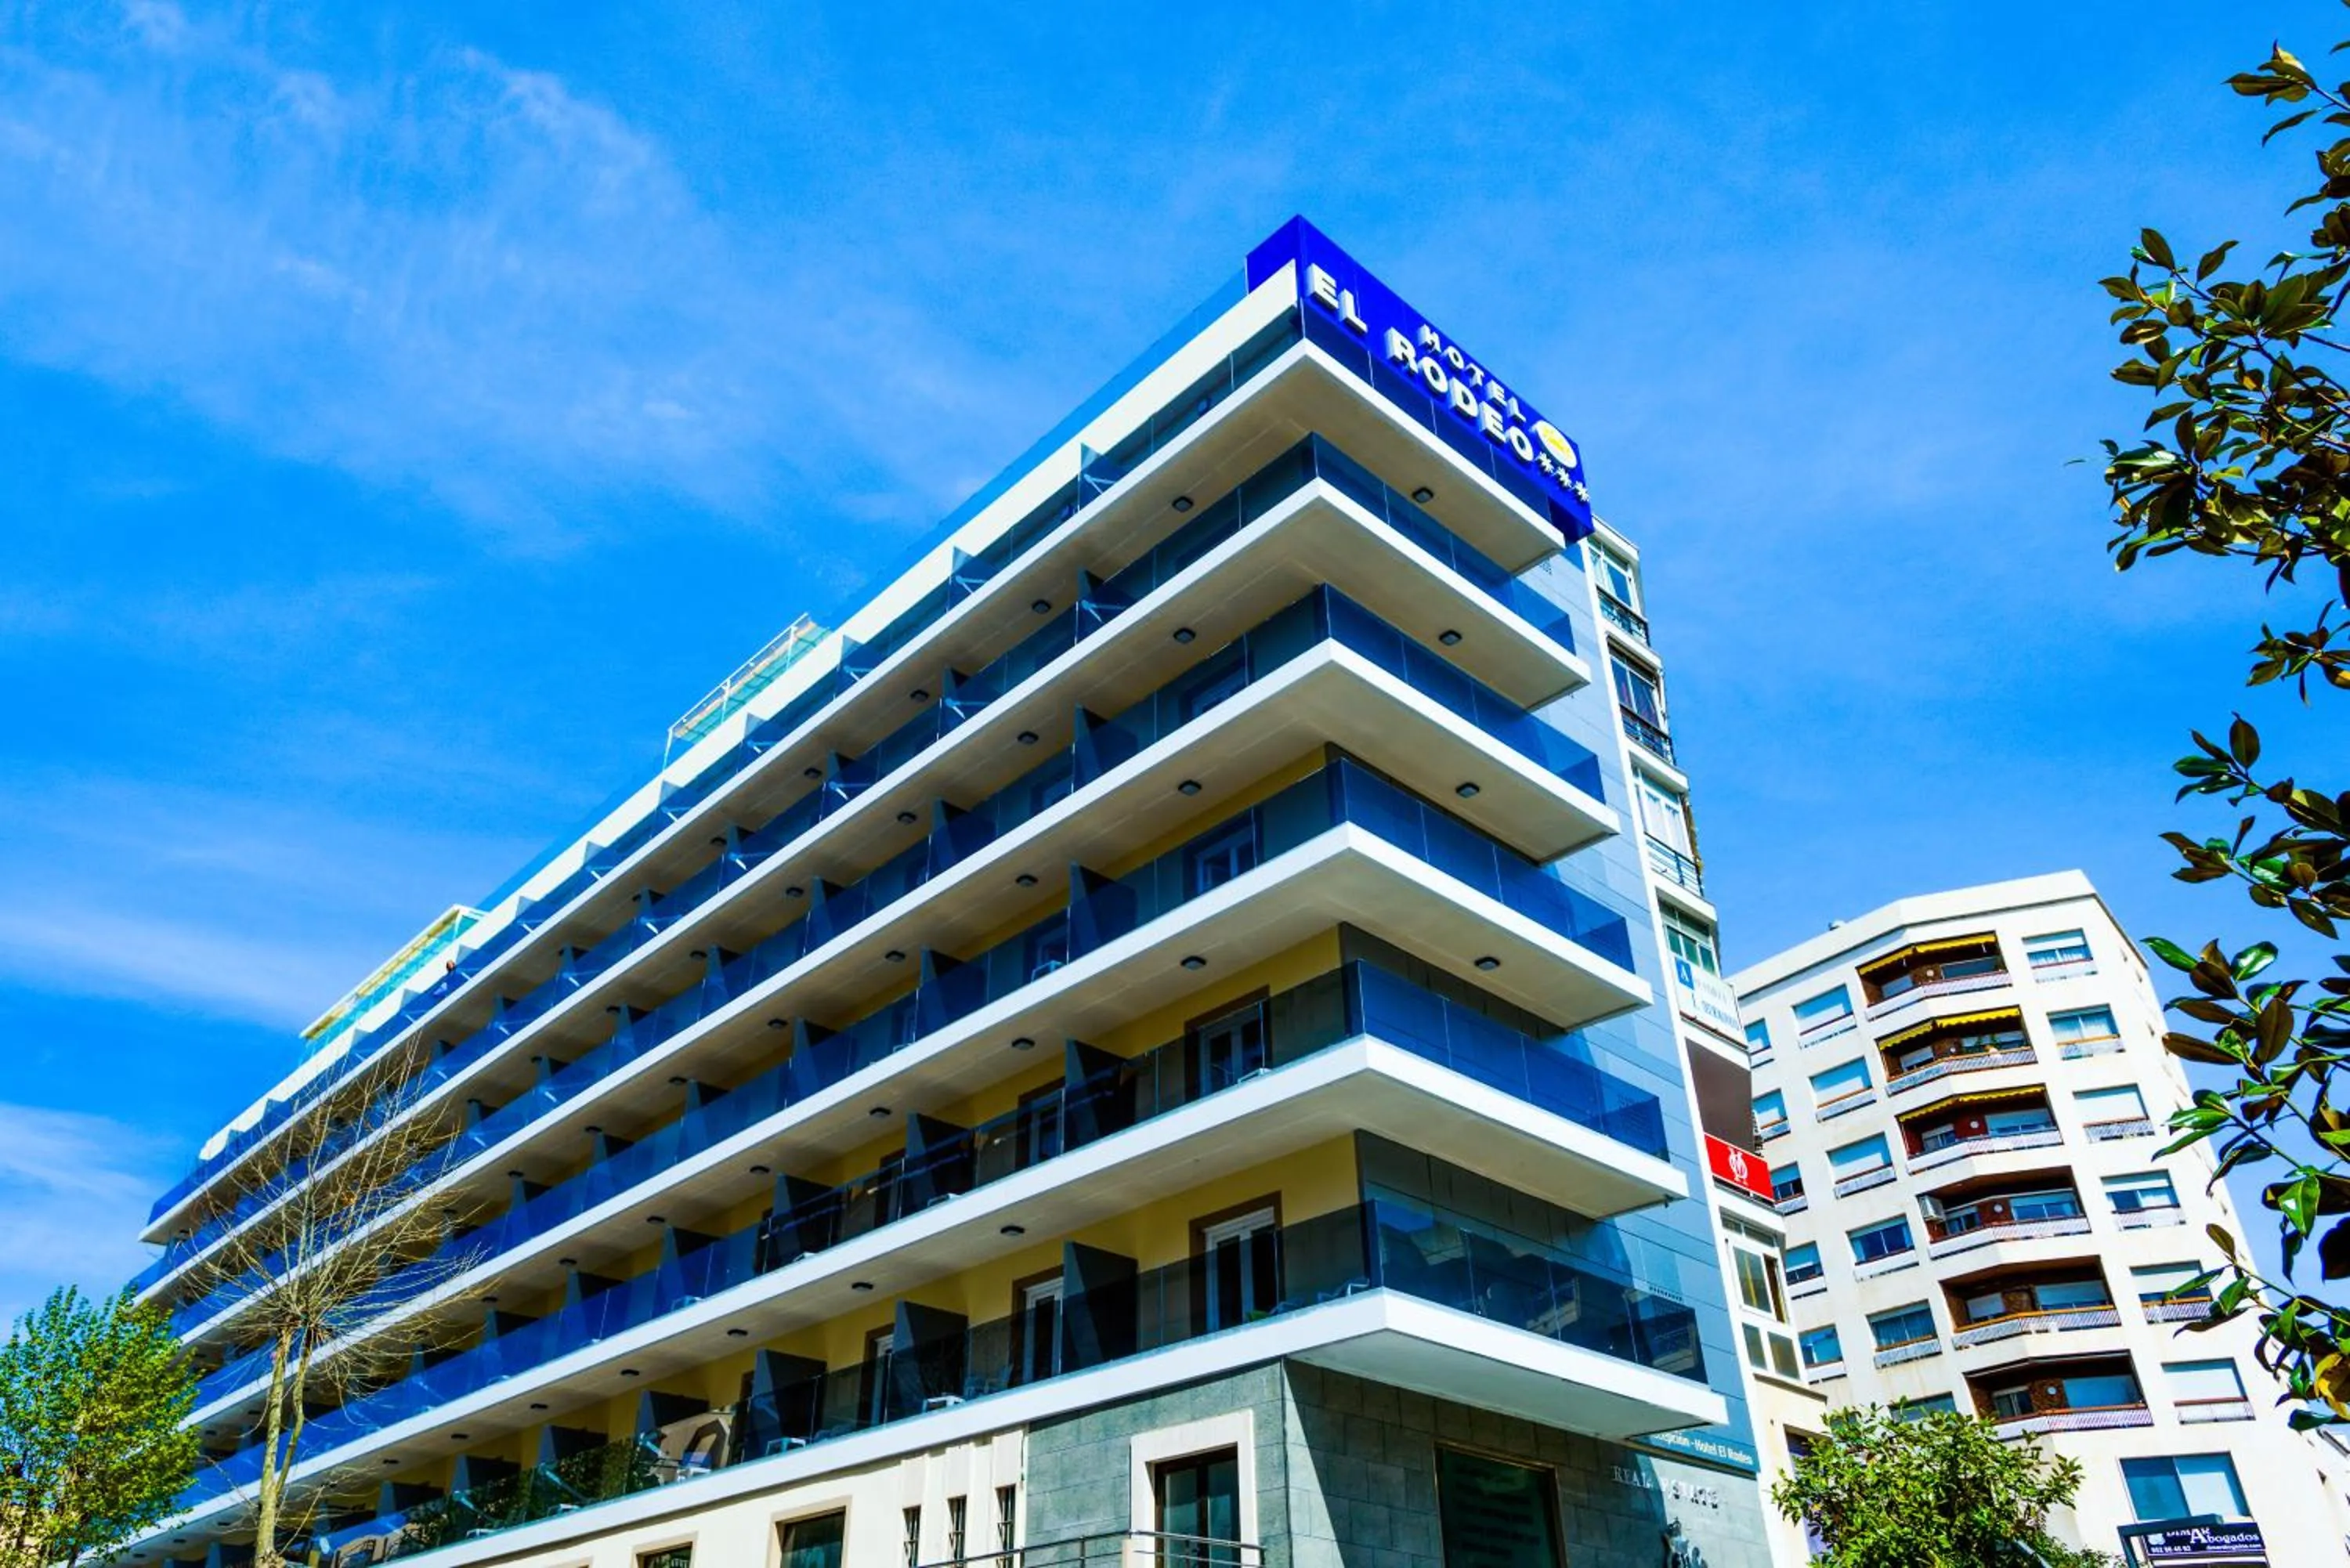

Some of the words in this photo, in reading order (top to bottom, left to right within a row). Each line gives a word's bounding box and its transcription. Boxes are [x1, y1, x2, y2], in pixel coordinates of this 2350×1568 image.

[1307, 262, 1368, 334] EL
[1384, 327, 1533, 462] RODEO
[1418, 324, 1527, 423] HOTEL
[1694, 1439, 1717, 1455] Hotel
[1717, 1445, 1726, 1458] El
[1611, 1465, 1653, 1488] REAL
[2190, 1528, 2259, 1544] Abogados
